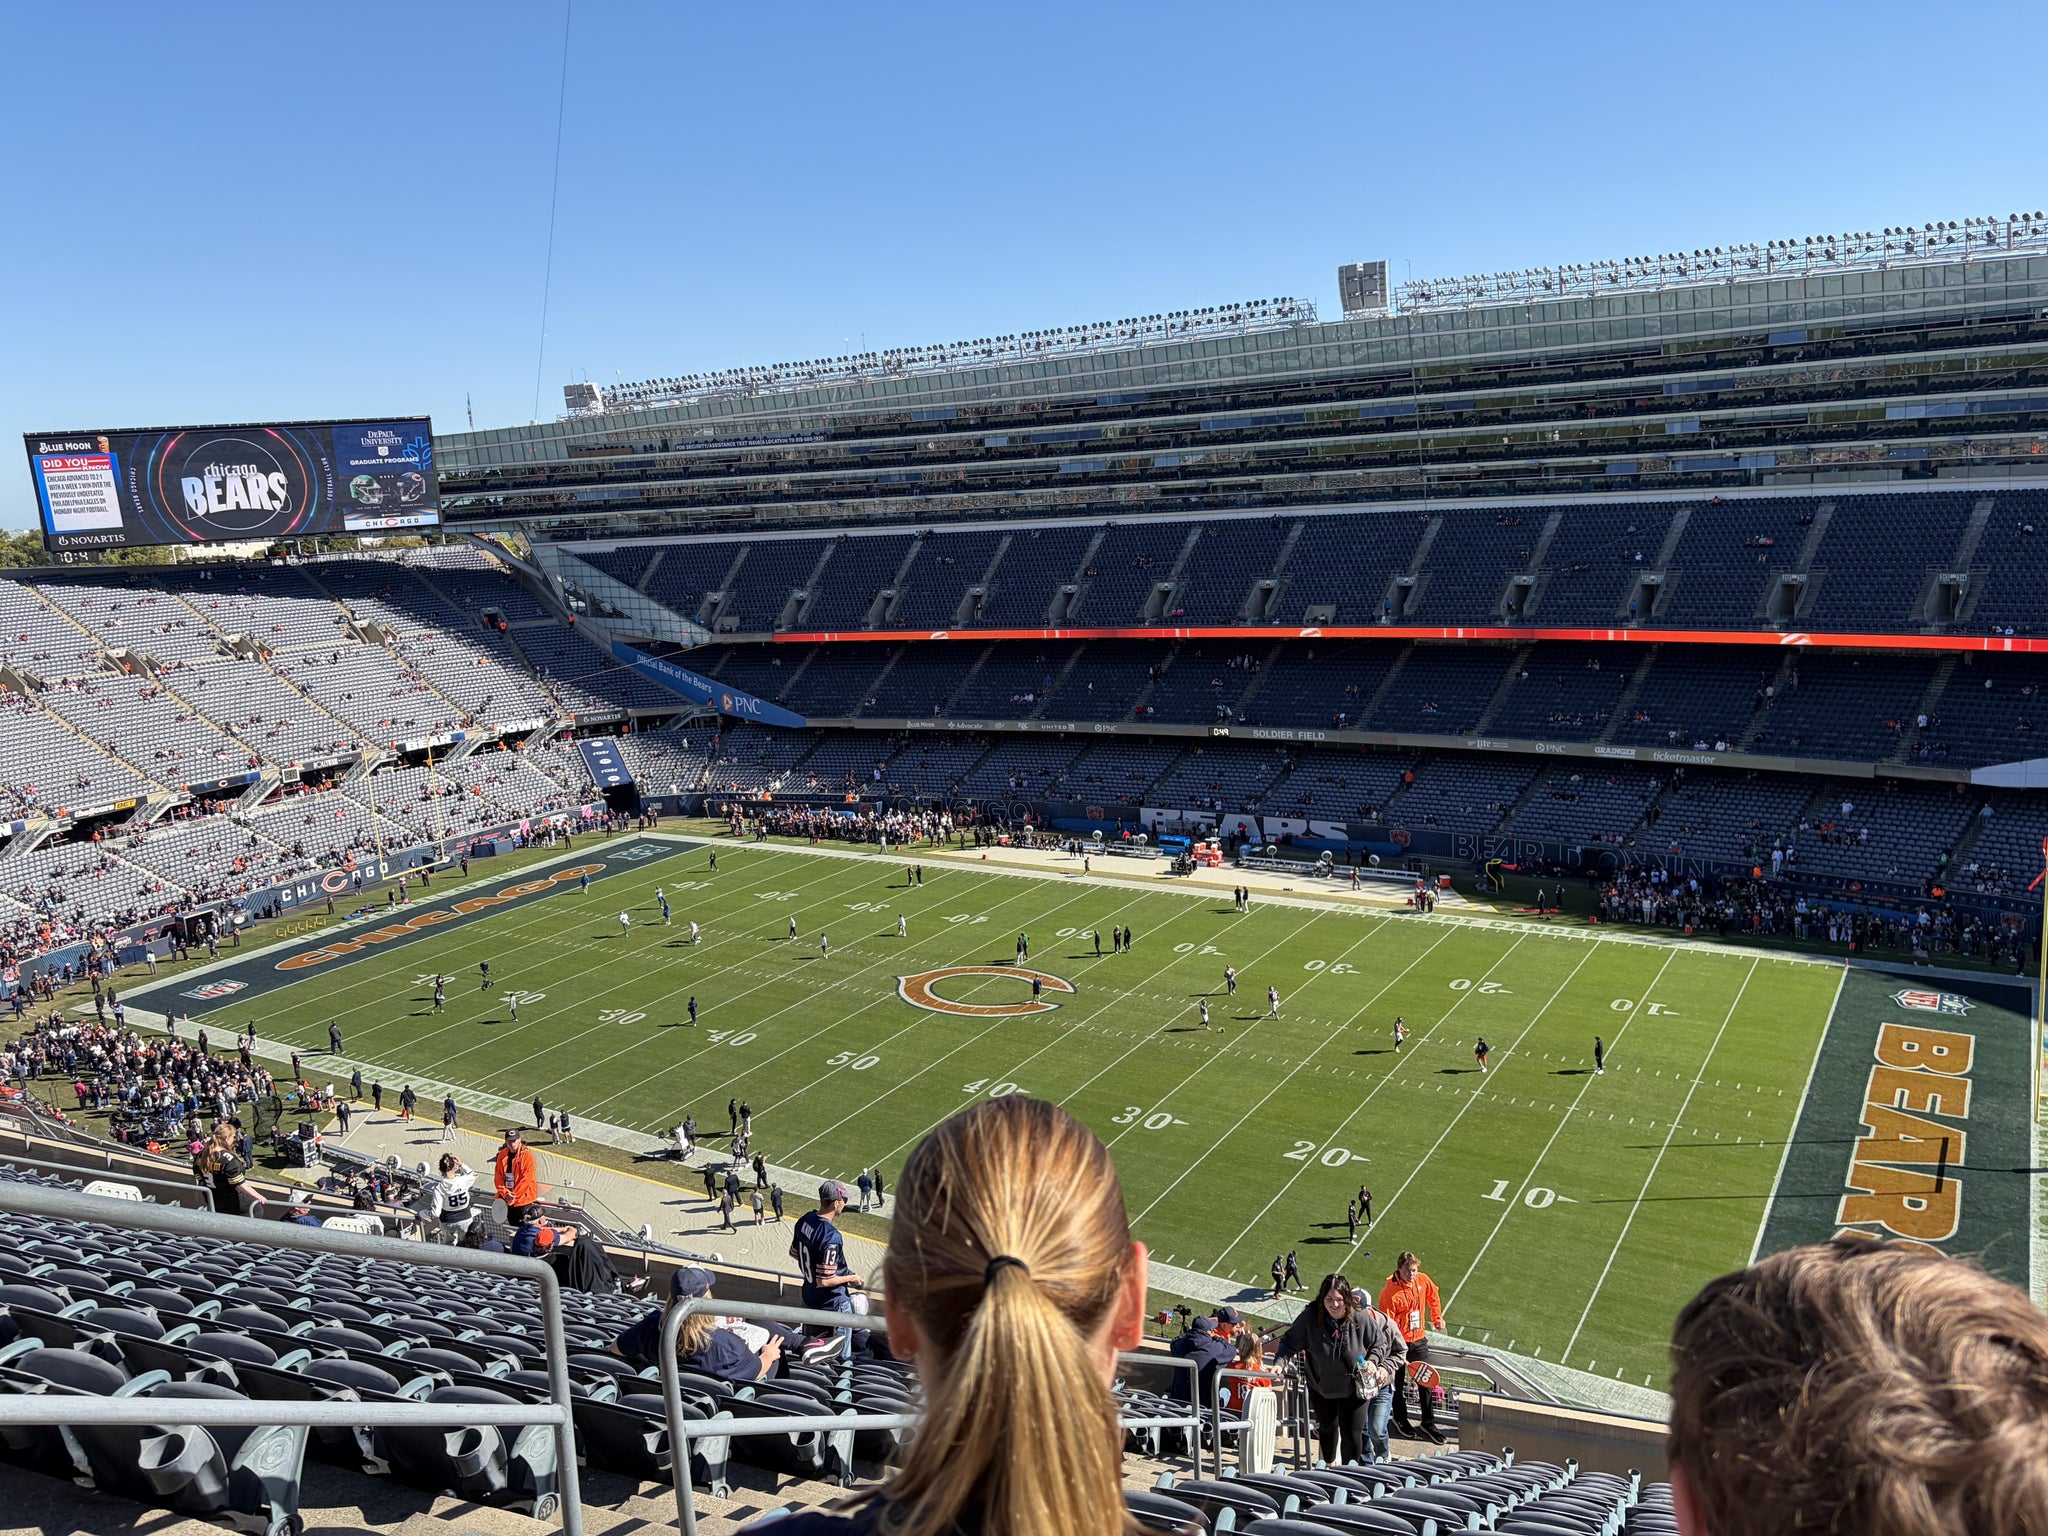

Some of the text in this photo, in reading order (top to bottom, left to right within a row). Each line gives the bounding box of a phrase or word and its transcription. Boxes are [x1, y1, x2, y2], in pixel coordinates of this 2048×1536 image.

[39, 442, 92, 454] BLUE MOON
[361, 437, 403, 446] UNIVERSITY
[42, 458, 88, 468] DID YOU
[349, 458, 383, 466] GRADUATE
[46, 475, 66, 483] CHICAGO
[50, 491, 76, 499] PREVIOUSLY
[181, 471, 289, 516] BEARS
[52, 499, 83, 507] PHILADELPHIA
[71, 534, 126, 545] NOVARTIS
[636, 654, 658, 670] Official
[658, 662, 675, 677] Bank
[682, 672, 693, 684] the
[693, 678, 712, 693] Bears
[734, 696, 762, 715] PNC
[589, 712, 622, 723] NOVARTIS
[496, 719, 544, 735] DOWN
[956, 722, 984, 730] Advocate
[1252, 729, 1326, 741] SOLDIER FIELD
[1546, 744, 1566, 753] PNC
[1594, 746, 1637, 757] GRAINGER
[1652, 751, 1717, 764] ticketmaster
[116, 800, 136, 811] BET
[851, 902, 890, 913] 30
[273, 863, 607, 971] CHICAGO
[949, 914, 990, 925] 40
[1333, 904, 1604, 939] INTECEPT CANCER
[1172, 942, 1219, 956] 40
[1303, 959, 1351, 975] 30
[1448, 978, 1502, 994] 20
[1610, 998, 1667, 1016] 10
[598, 1008, 647, 1025] 30
[706, 1029, 758, 1047] 40
[826, 1051, 880, 1070] 50
[962, 1078, 1018, 1098] 40
[1111, 1106, 1174, 1130] 30
[1283, 1140, 1351, 1168] 20
[448, 1192, 468, 1208] 85
[1481, 1179, 1557, 1209] 10
[799, 1241, 814, 1285] 13
[824, 1250, 837, 1266] 13
[1421, 1369, 1434, 1384] NO
